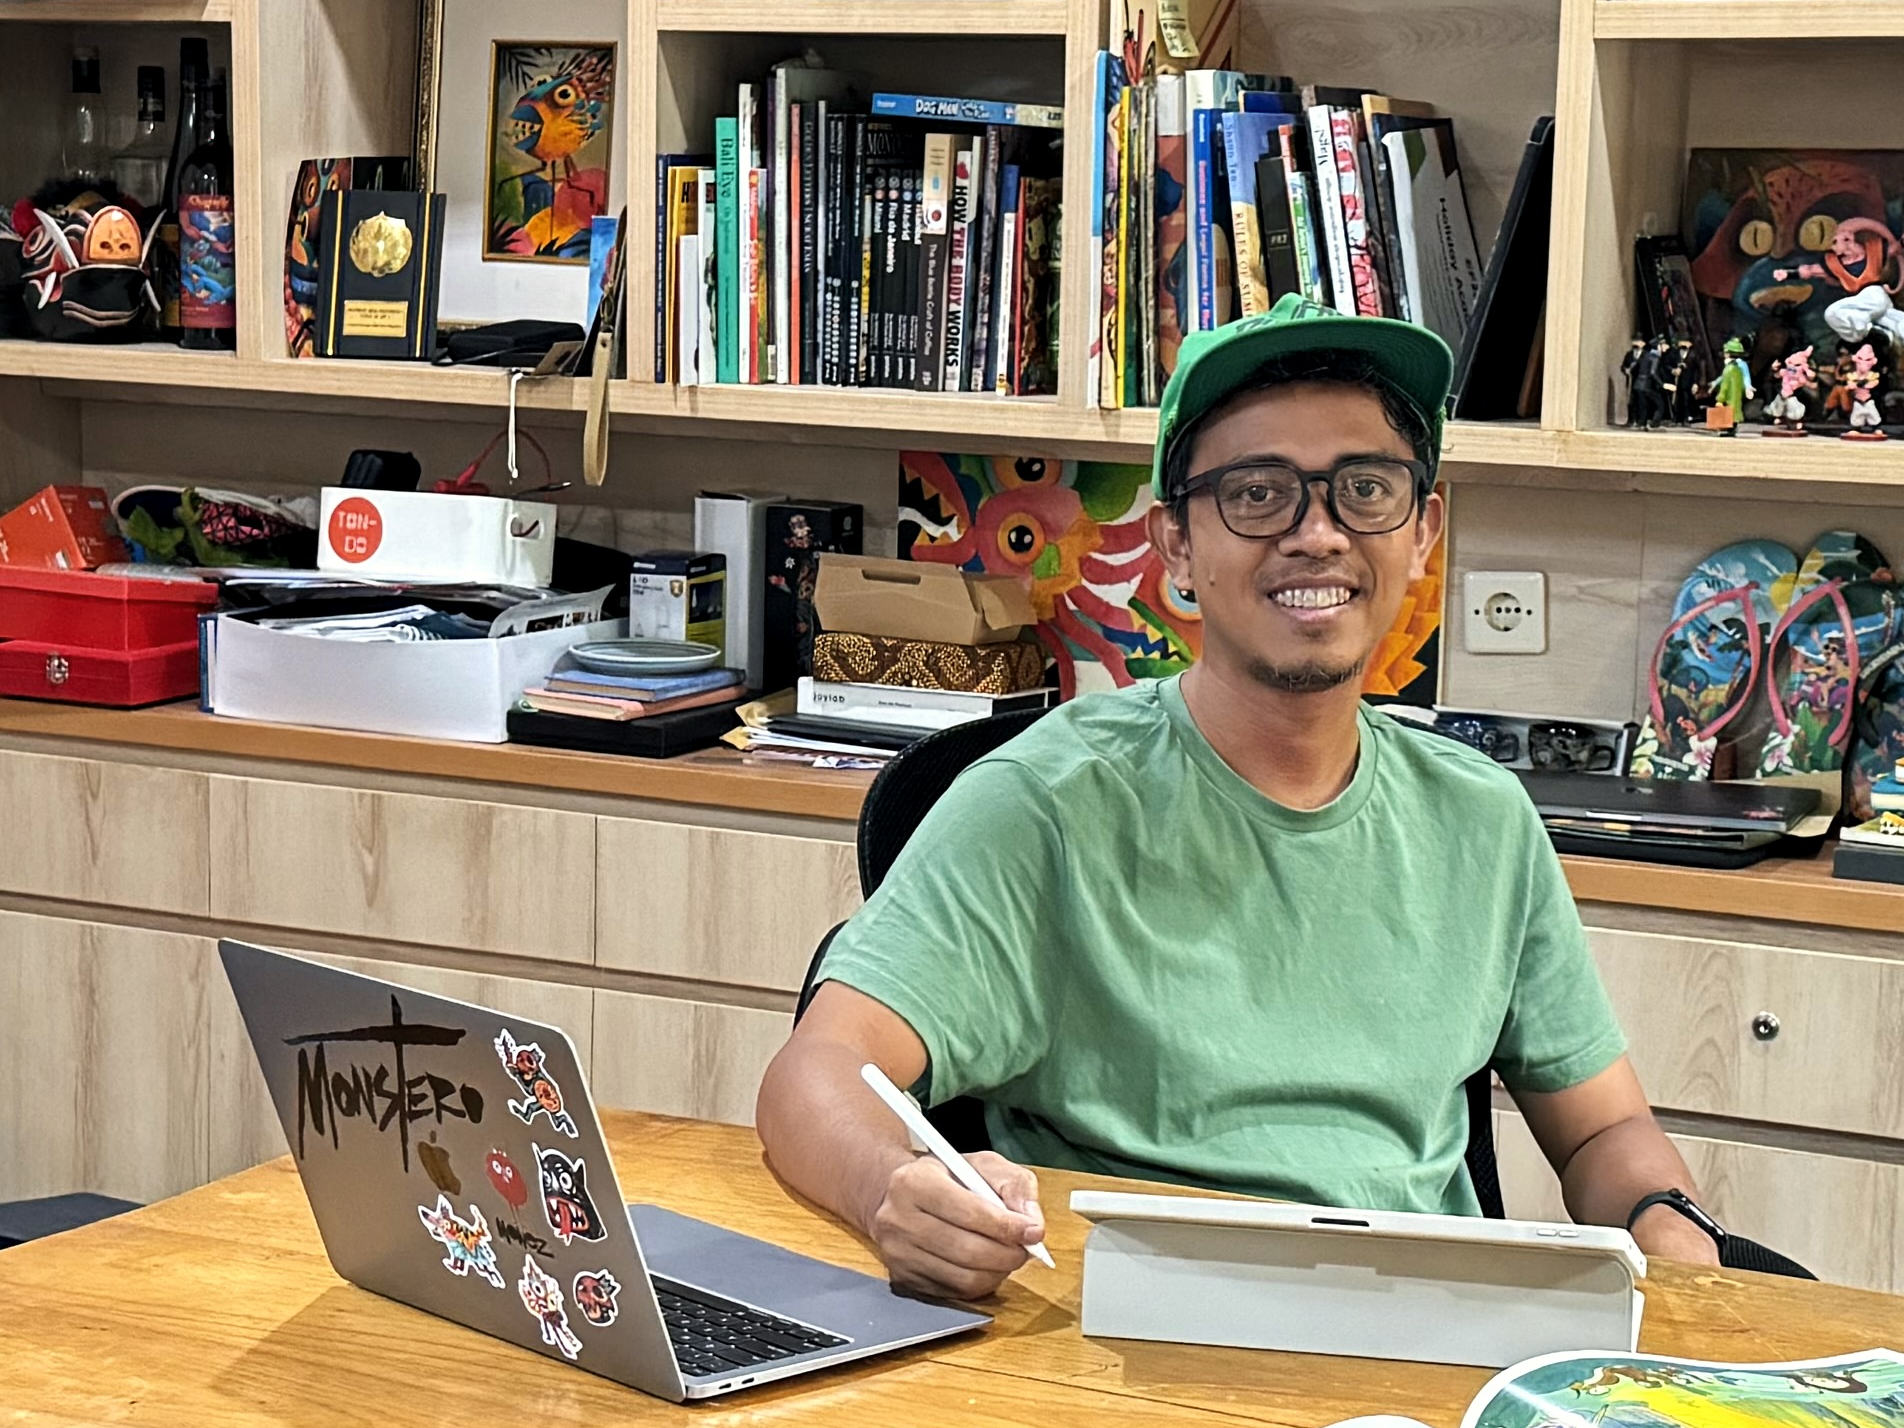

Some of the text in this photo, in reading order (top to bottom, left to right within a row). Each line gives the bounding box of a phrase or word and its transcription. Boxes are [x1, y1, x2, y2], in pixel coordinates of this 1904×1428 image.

[915, 98, 960, 116] DOG MAN
[716, 138, 736, 198] Bali Eye
[872, 201, 885, 234] Miami
[900, 203, 913, 241] Madrid
[884, 201, 899, 273] Rio de Janeiro
[926, 243, 938, 259] The
[945, 185, 969, 368] HOW THE BODY WORKS
[337, 510, 378, 530] TON-
[283, 993, 485, 1175] MONSTERO
